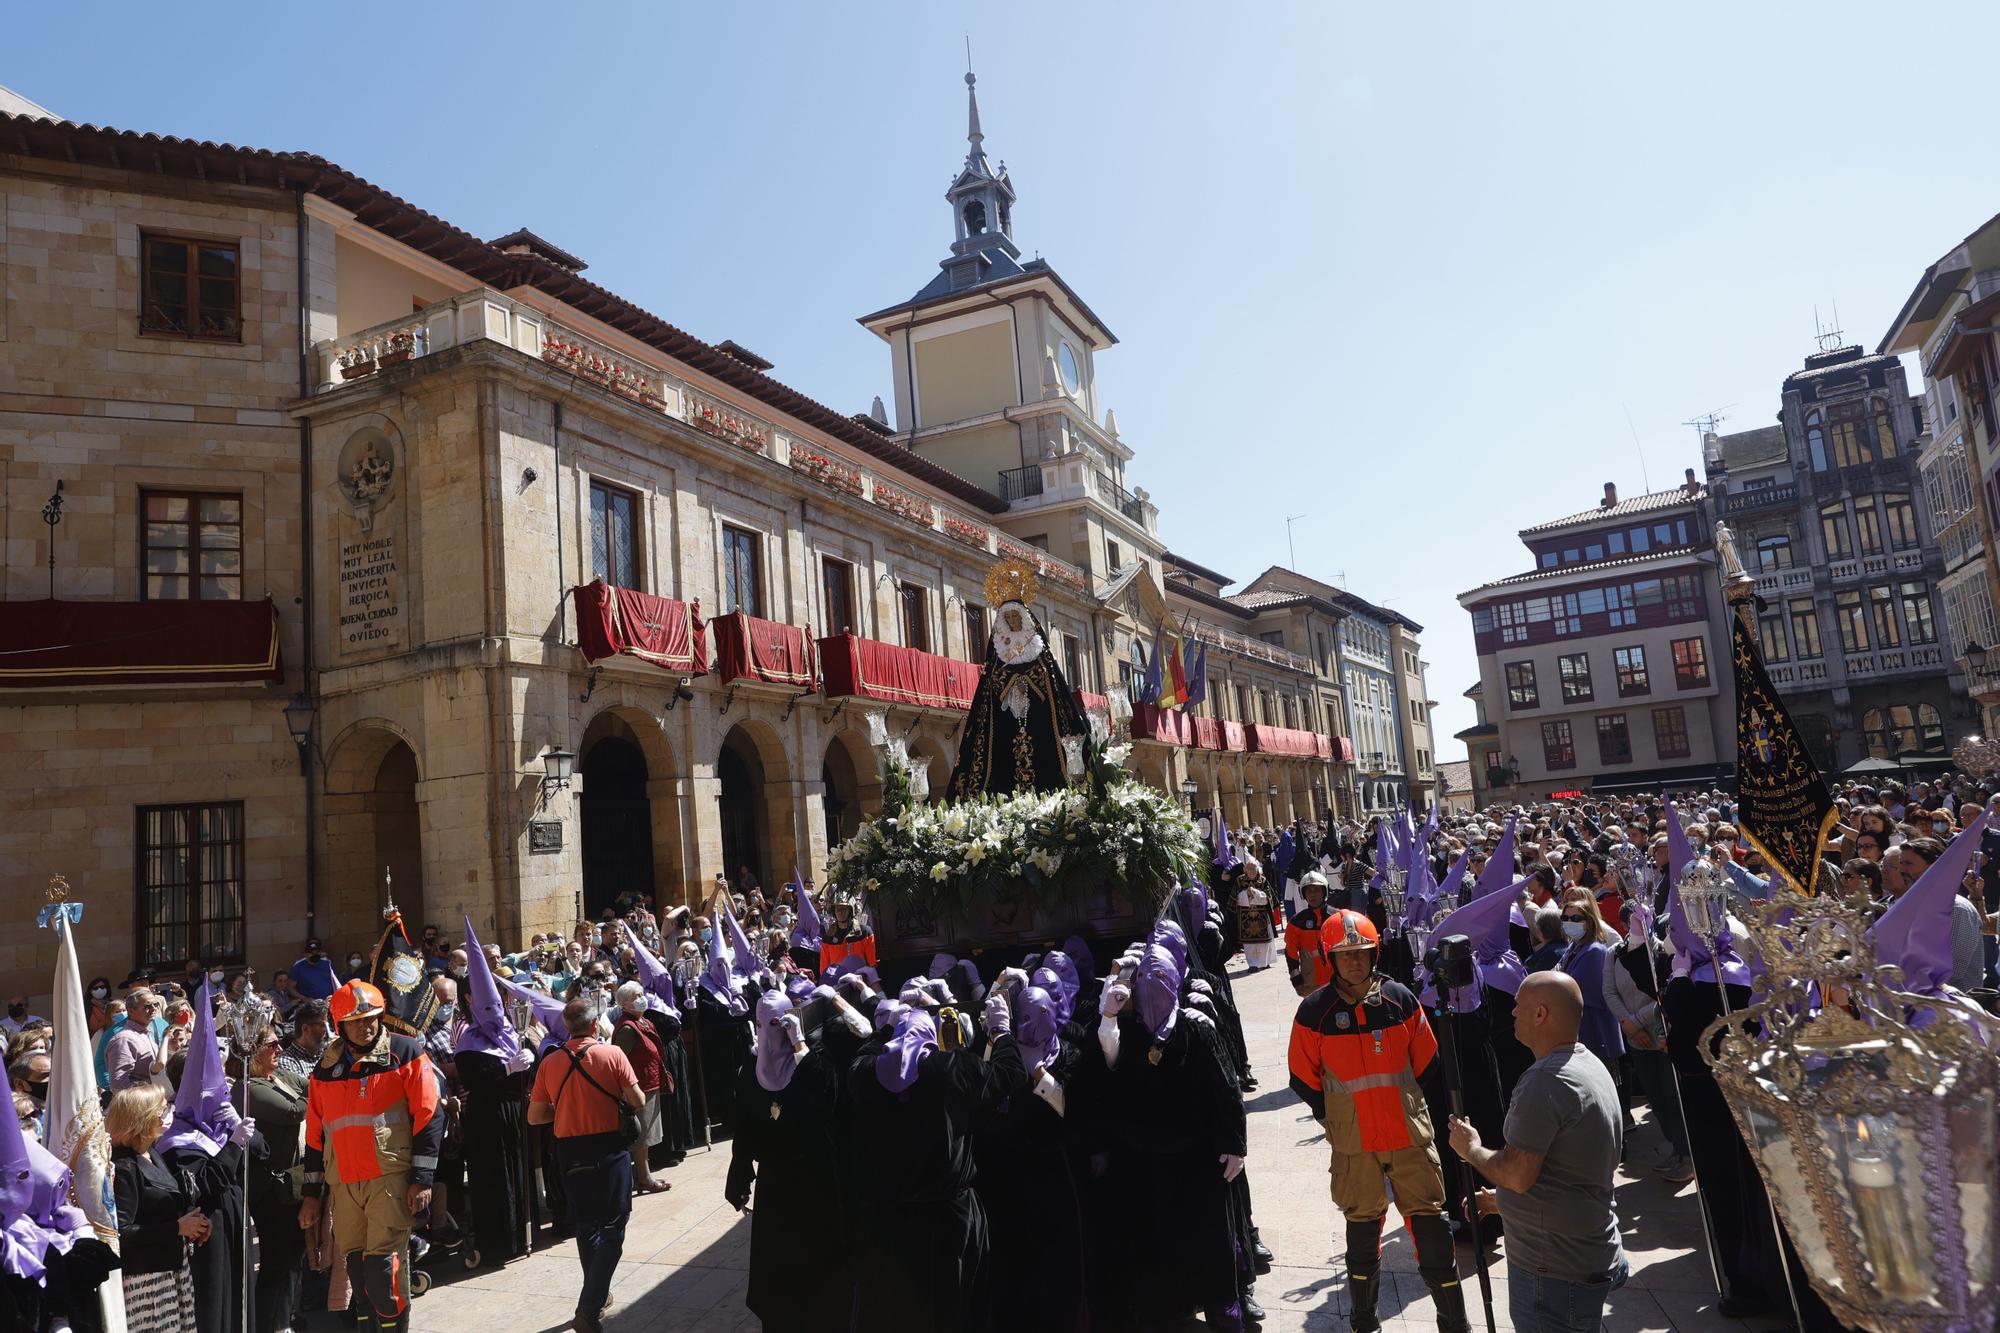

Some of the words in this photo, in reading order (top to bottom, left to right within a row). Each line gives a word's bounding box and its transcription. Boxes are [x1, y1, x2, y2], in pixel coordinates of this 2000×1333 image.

[343, 543, 361, 556] MUY
[363, 537, 392, 552] NOBLE
[343, 556, 361, 568] MUY
[367, 551, 392, 563] LEAL
[341, 563, 396, 582] BENEMERITA
[349, 577, 388, 593] INVICTA
[349, 589, 389, 606] HEROICA
[341, 613, 366, 625] BUENA
[367, 607, 398, 620] CIUDAD
[363, 622, 373, 630] DE
[349, 628, 389, 642] OVIEDO
